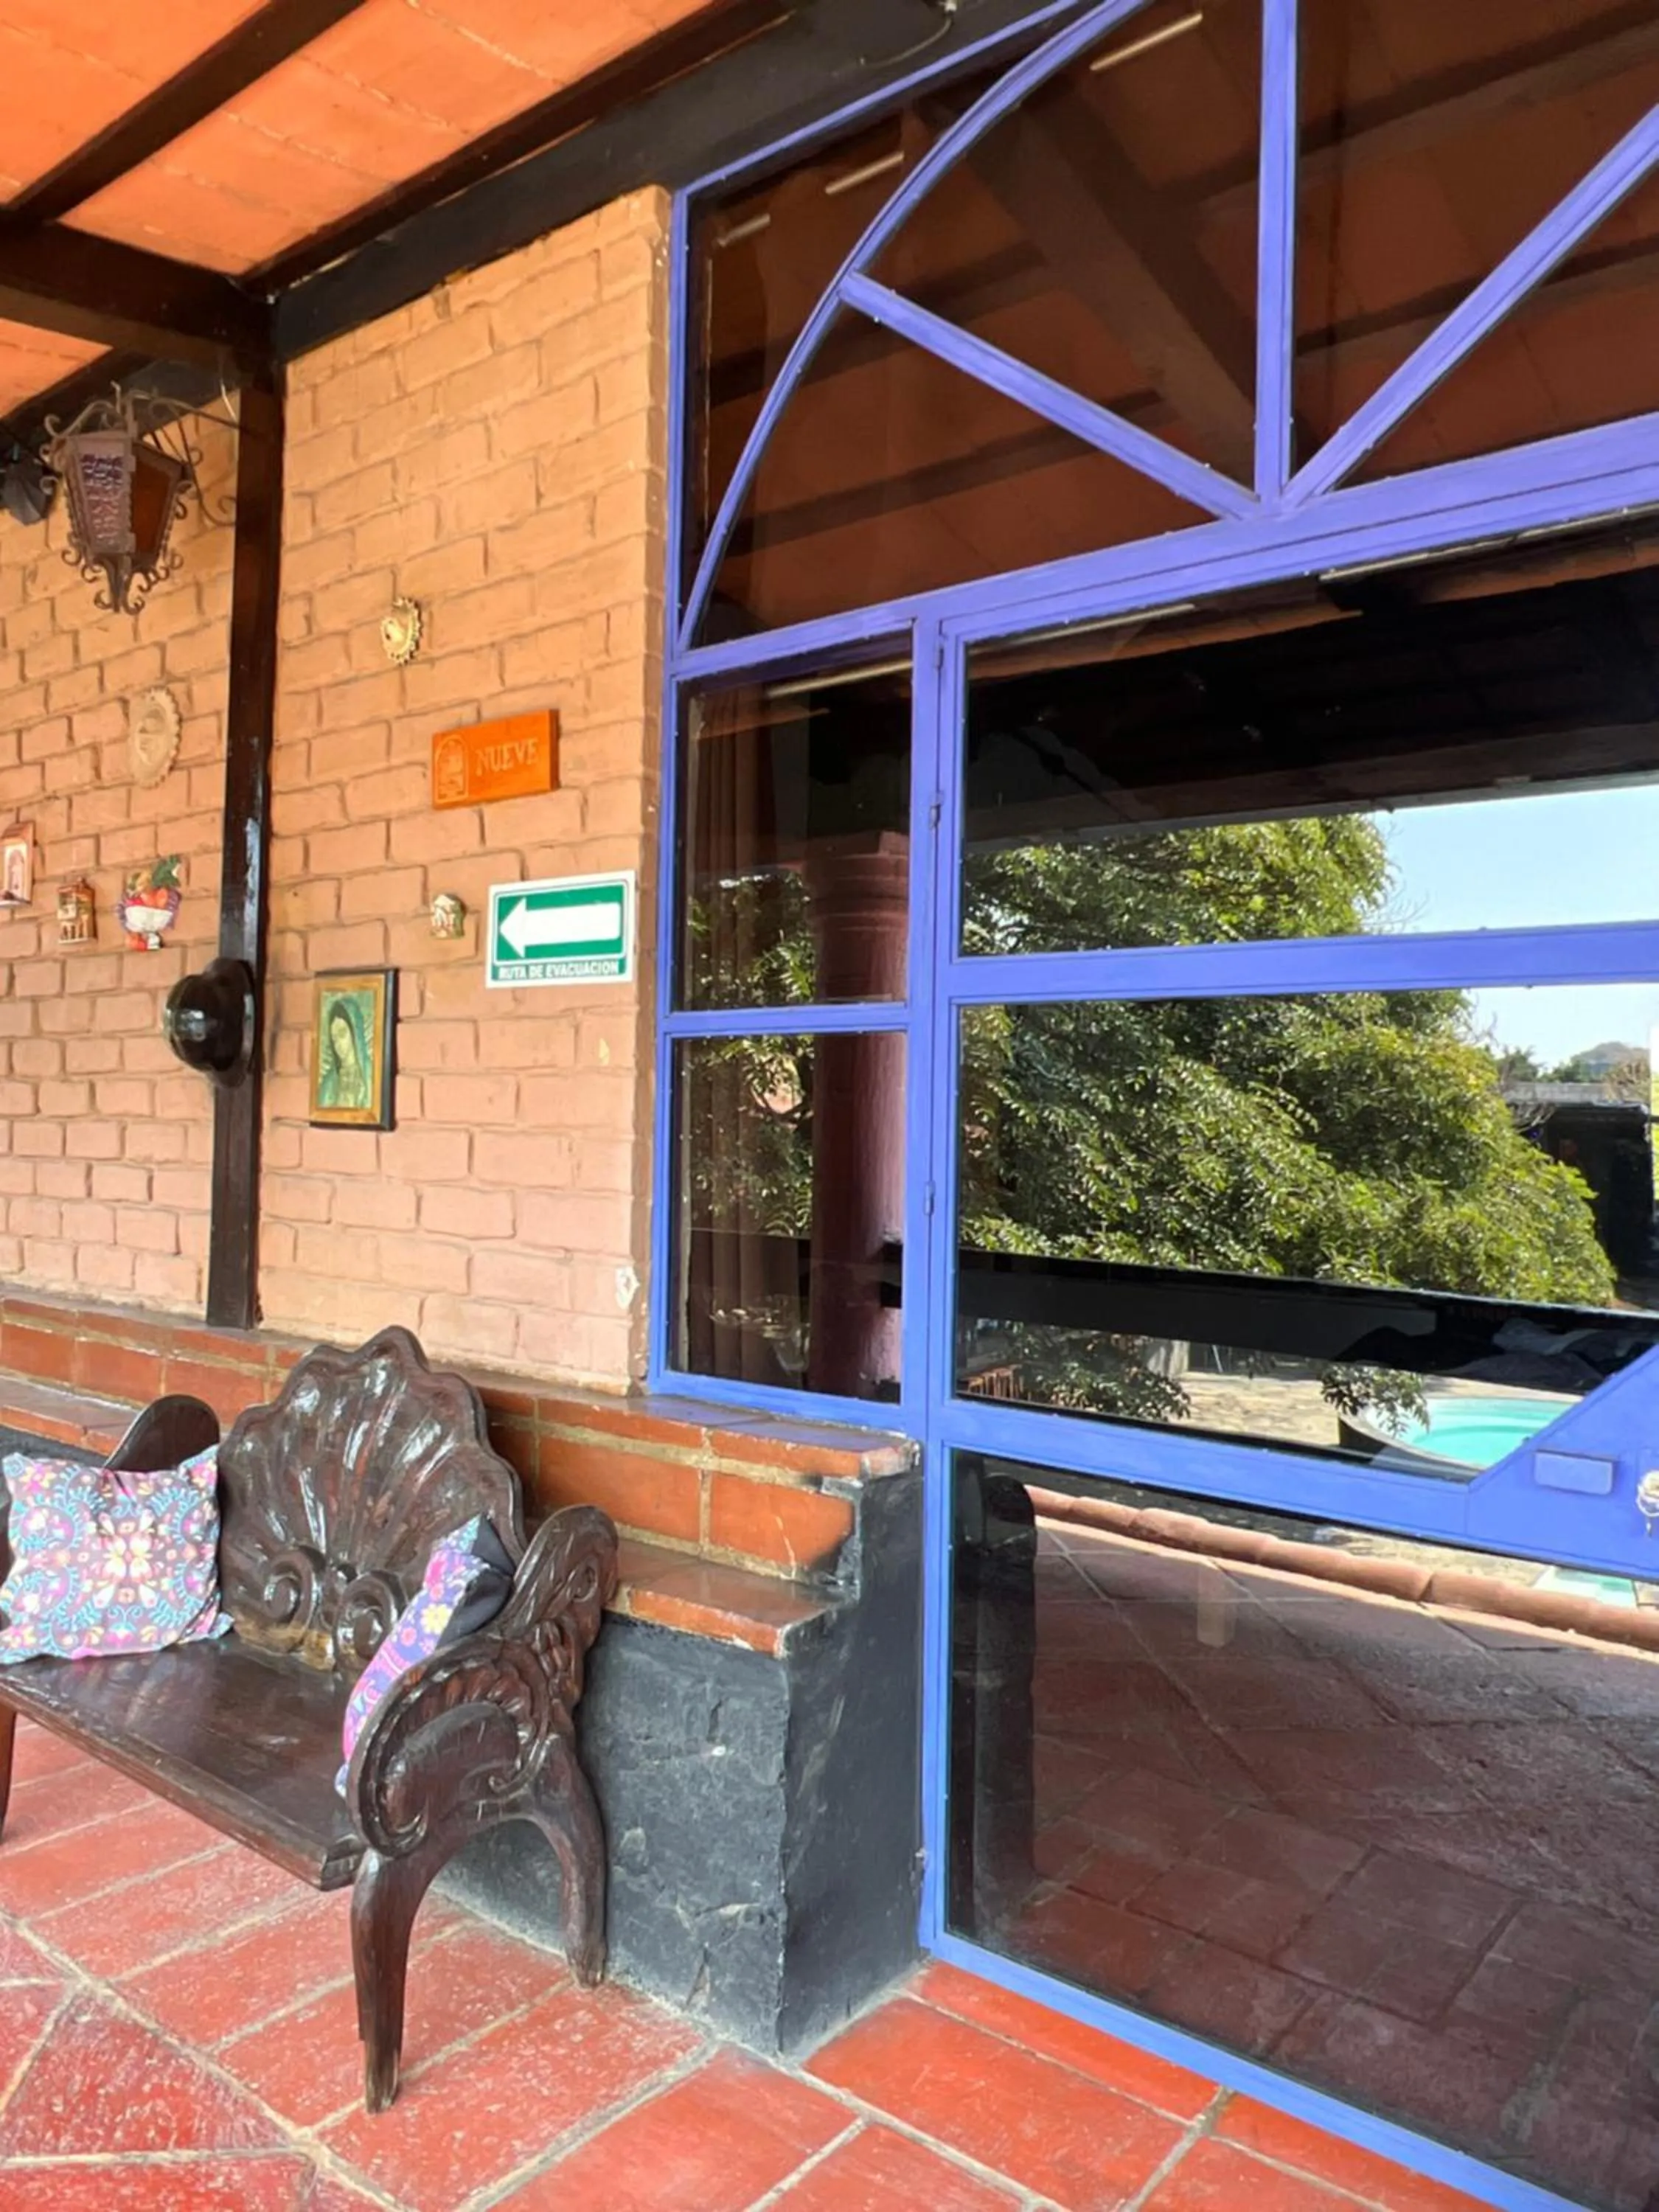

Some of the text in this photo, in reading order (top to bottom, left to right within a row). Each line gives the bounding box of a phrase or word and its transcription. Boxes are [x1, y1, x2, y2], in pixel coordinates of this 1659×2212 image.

[474, 737, 538, 776] NUEVE
[498, 961, 618, 979] RUTA DE EVACUACION
